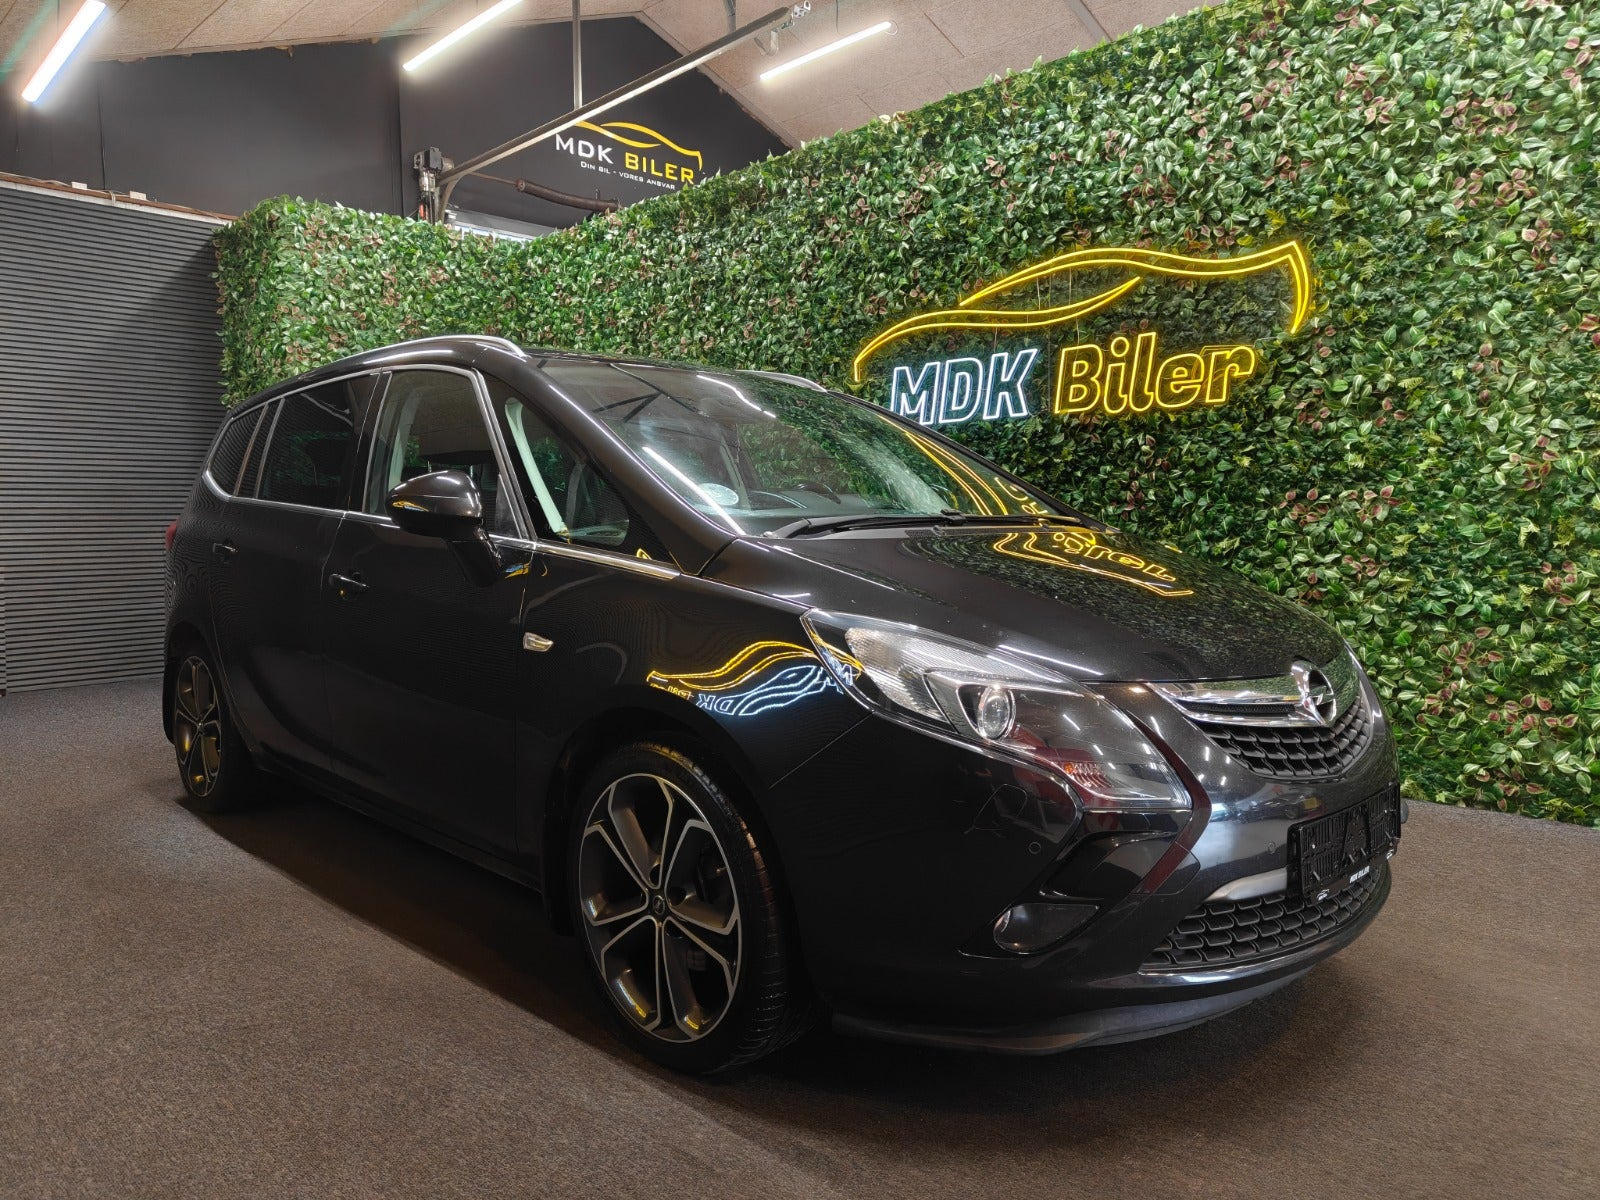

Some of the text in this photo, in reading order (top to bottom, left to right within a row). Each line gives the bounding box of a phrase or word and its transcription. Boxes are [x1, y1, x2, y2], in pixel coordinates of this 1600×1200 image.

[555, 133, 695, 184] MDK BILER
[890, 331, 1256, 426] MDK Biler
